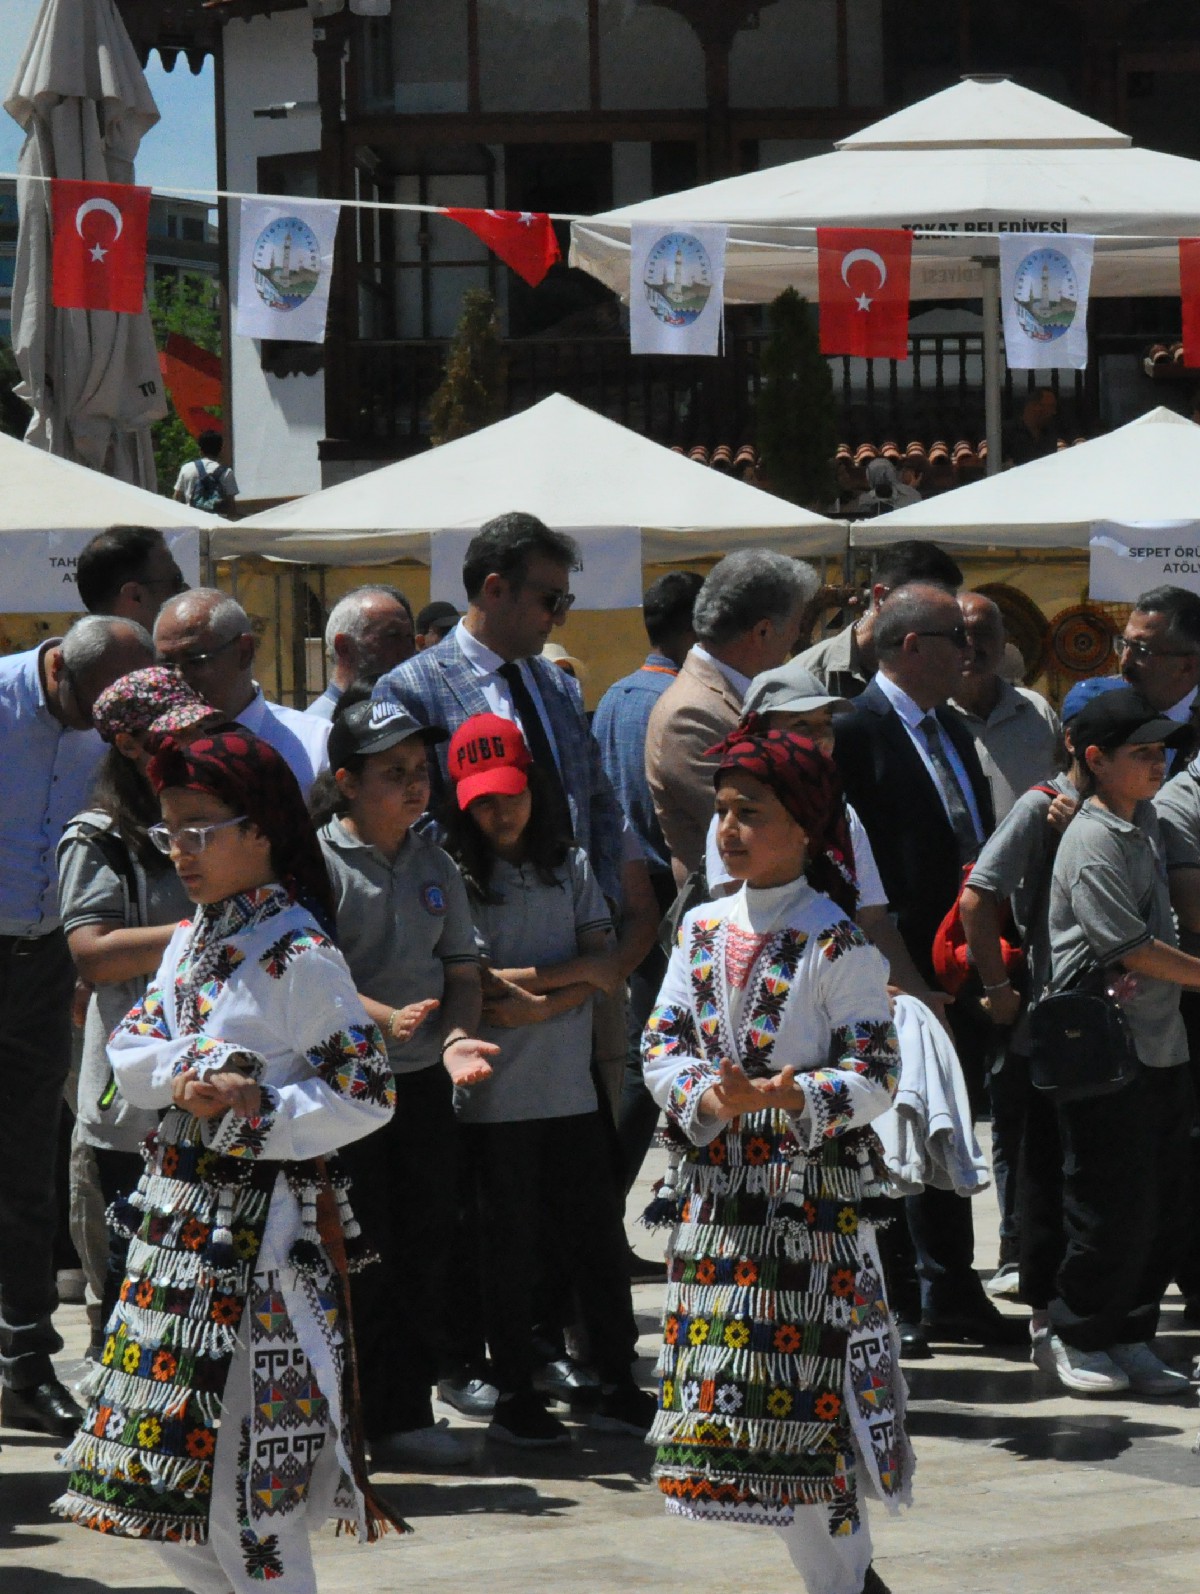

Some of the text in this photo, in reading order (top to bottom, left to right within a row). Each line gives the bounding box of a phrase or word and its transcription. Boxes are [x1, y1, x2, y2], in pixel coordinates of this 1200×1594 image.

[1128, 547, 1171, 558] SEPET
[49, 557, 78, 568] TAH
[372, 702, 402, 721] NIKE
[456, 736, 505, 770] PUBG
